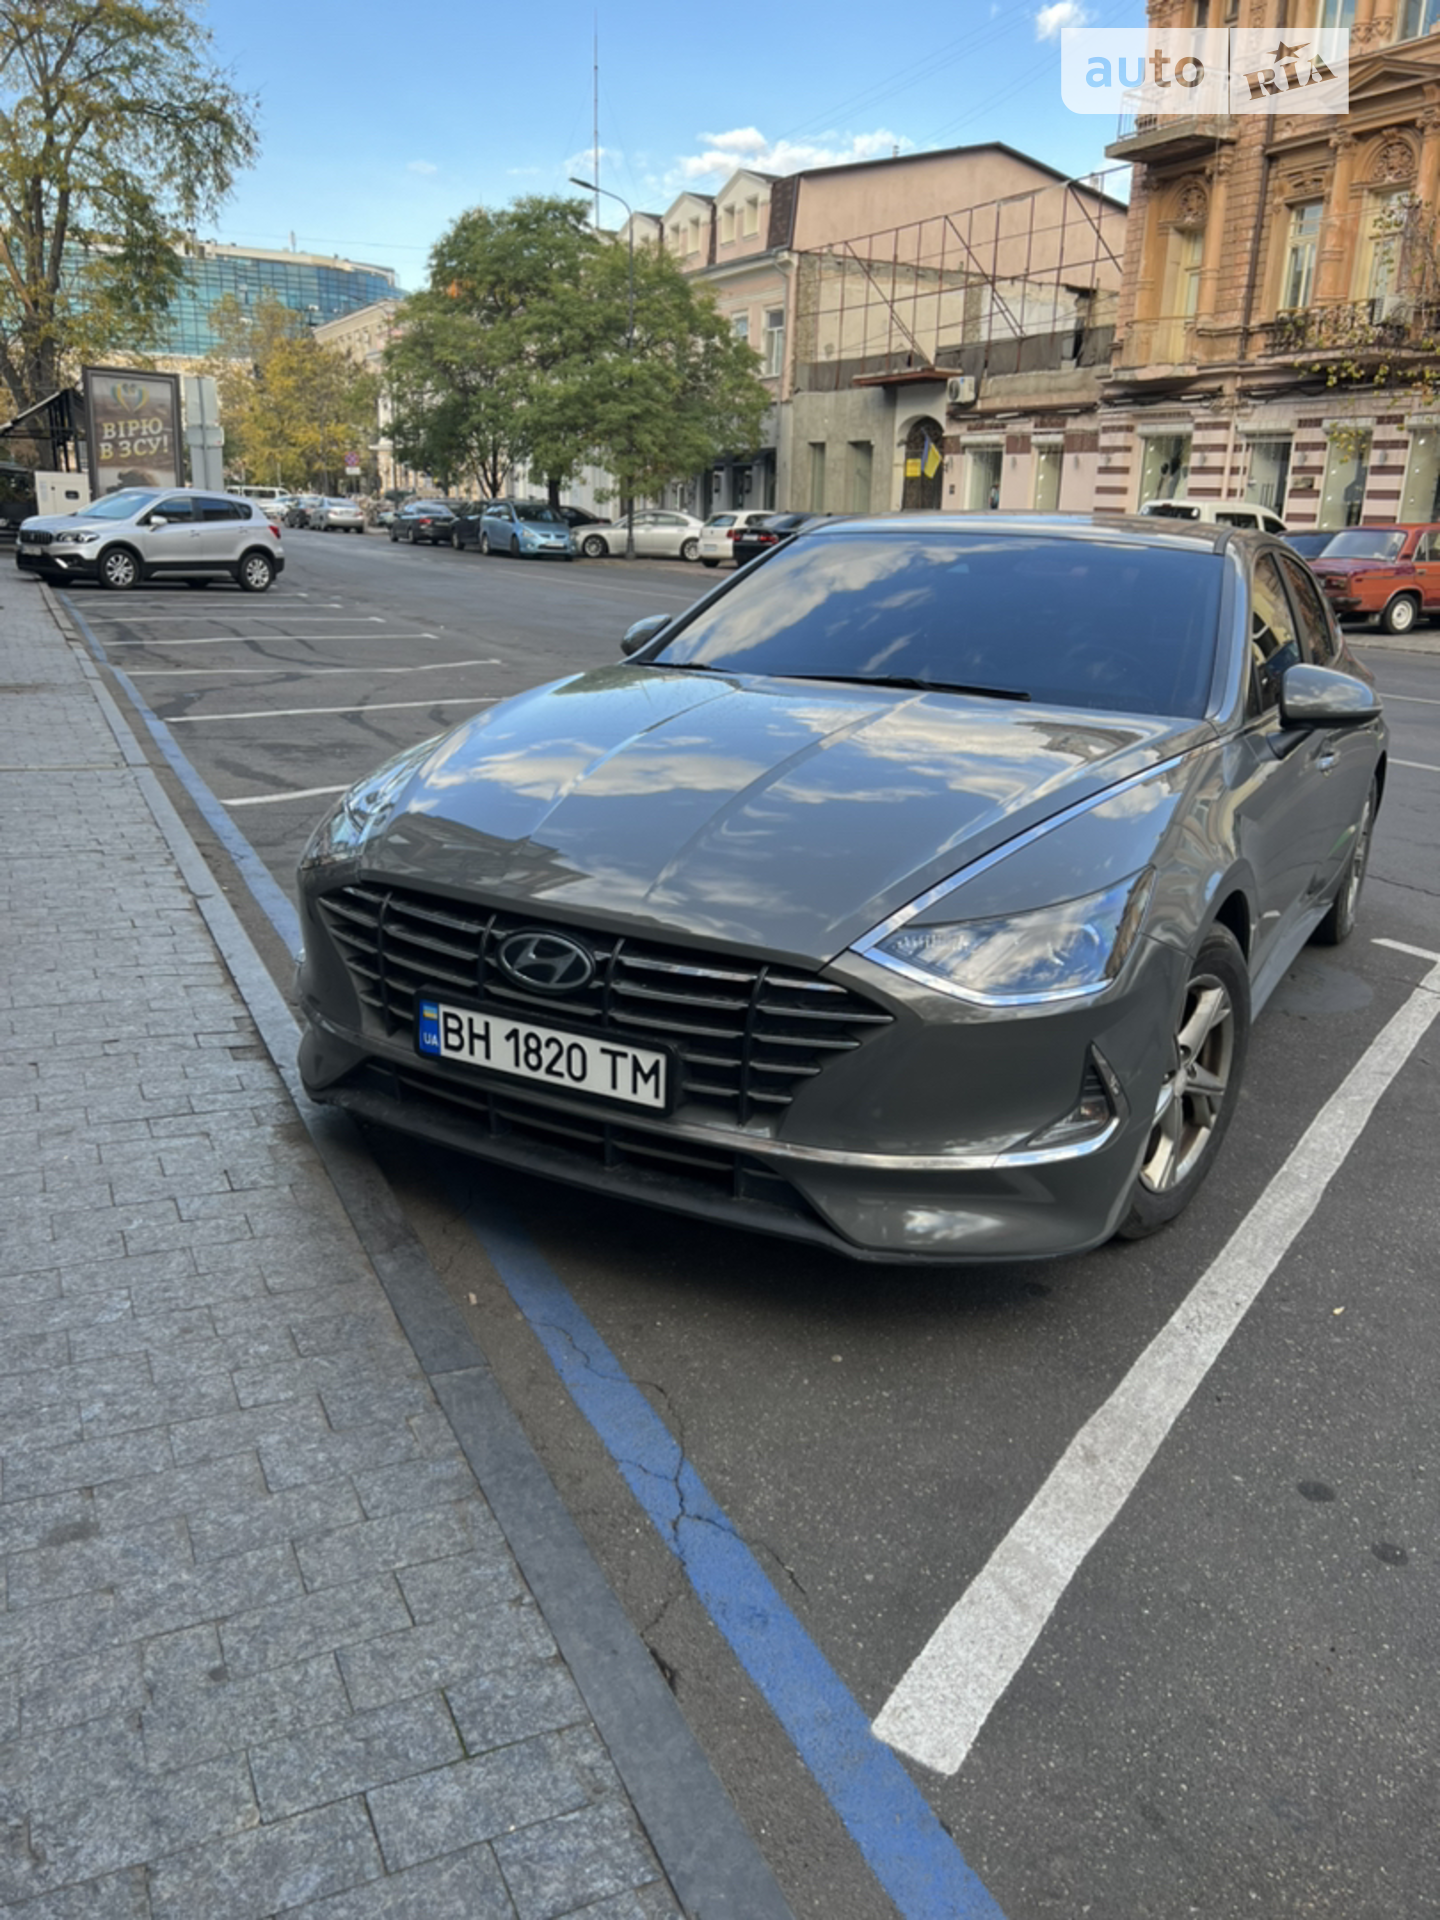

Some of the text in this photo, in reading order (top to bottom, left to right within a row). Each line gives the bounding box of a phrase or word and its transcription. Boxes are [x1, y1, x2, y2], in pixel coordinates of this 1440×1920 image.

[103, 418, 162, 439] ВІРЮ
[100, 436, 168, 459] В ЗСУ!
[423, 1032, 438, 1046] UA
[442, 1011, 661, 1100] BH 1820 TM
